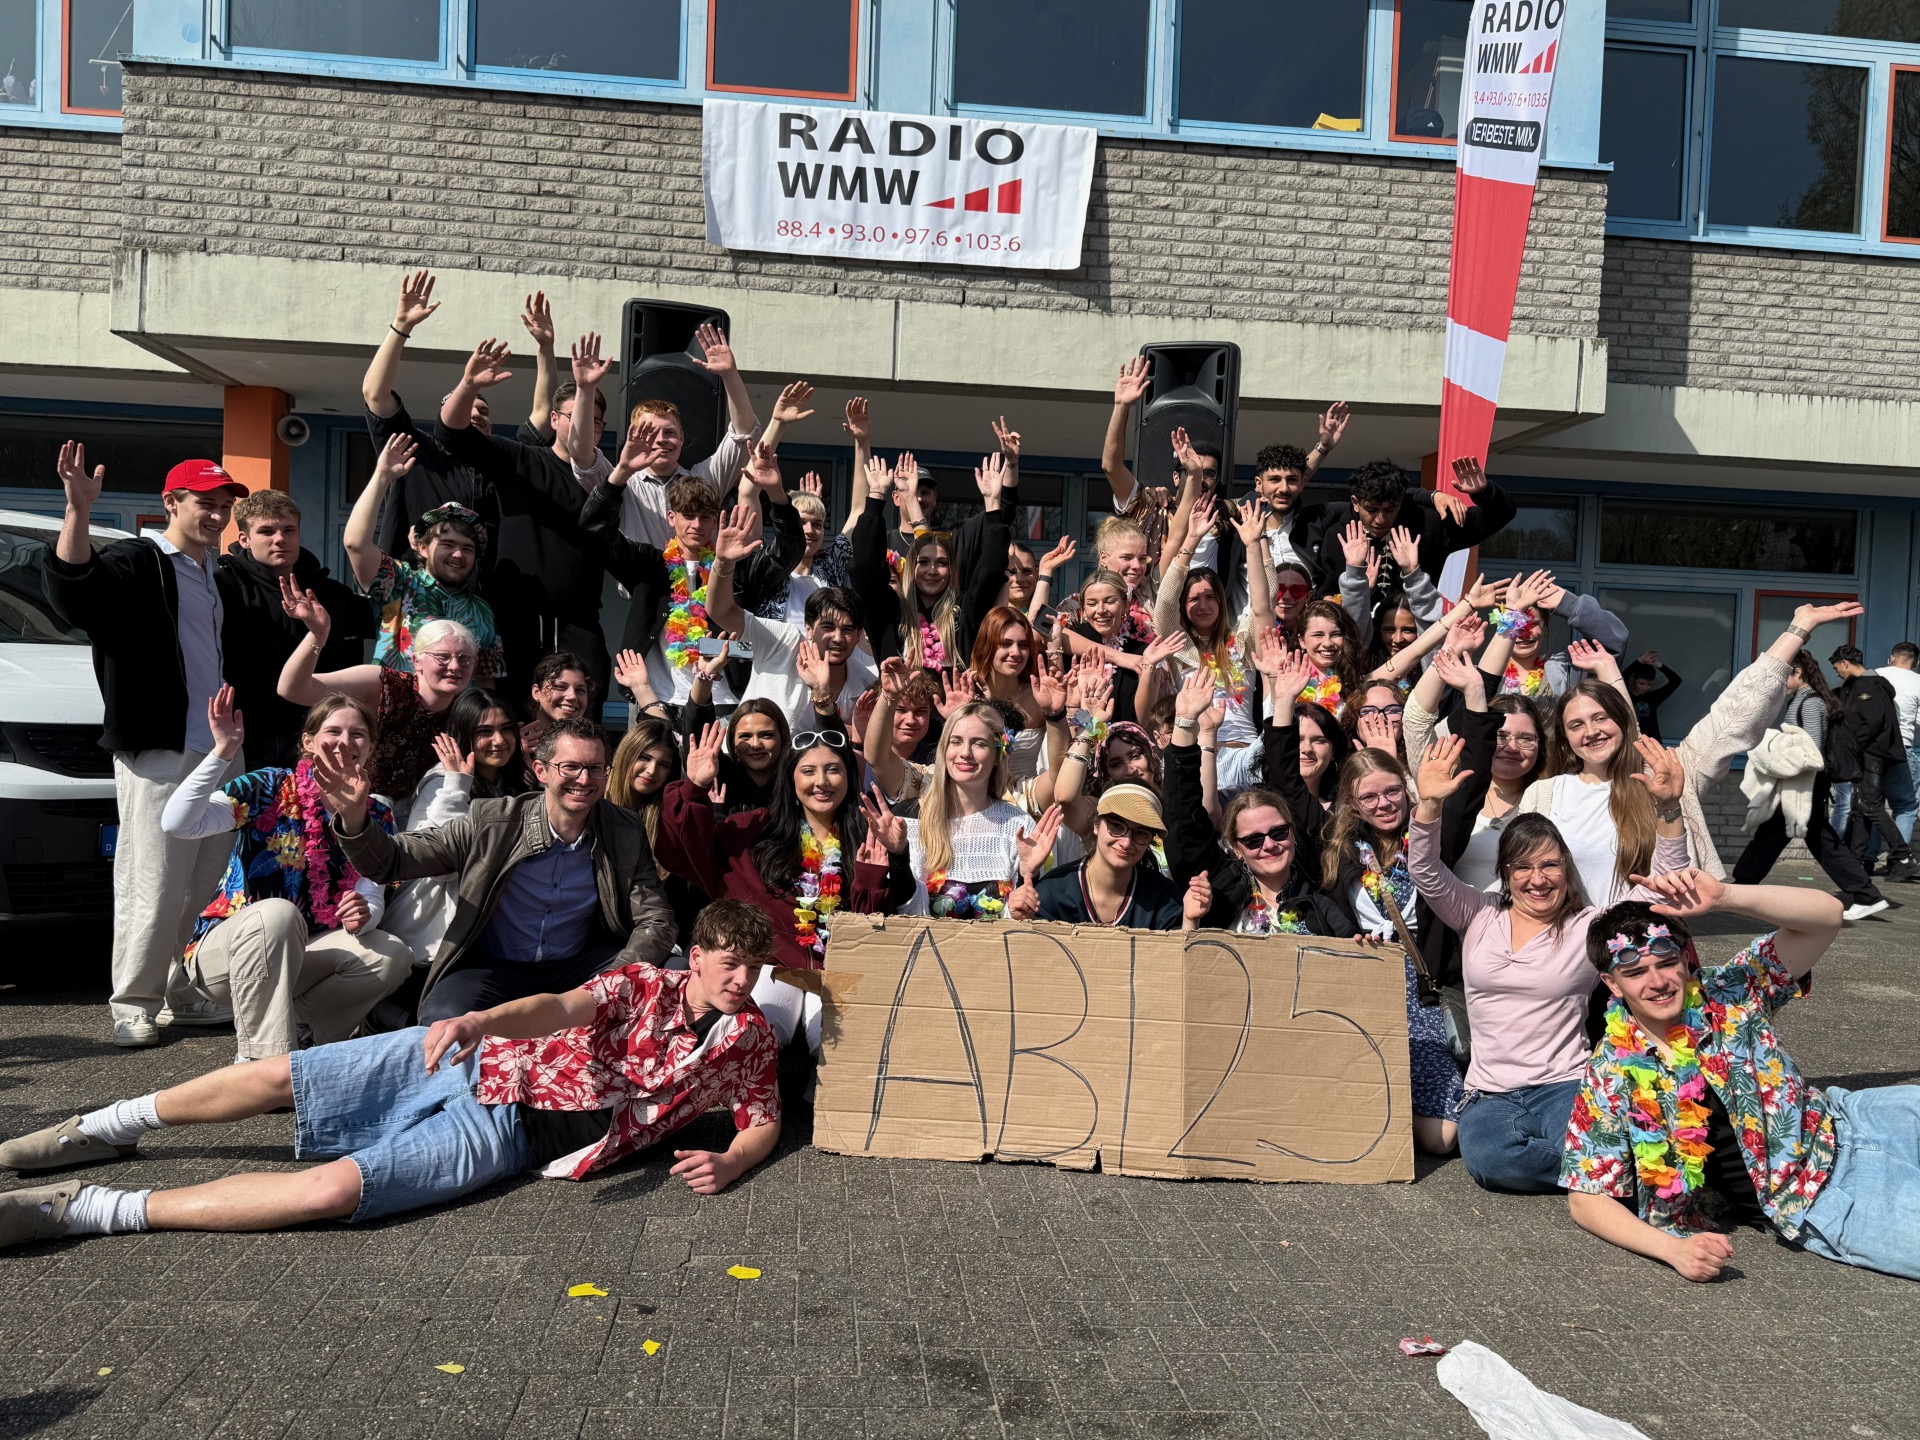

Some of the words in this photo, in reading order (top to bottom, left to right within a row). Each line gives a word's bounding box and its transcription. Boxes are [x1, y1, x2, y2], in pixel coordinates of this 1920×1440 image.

[1481, 0, 1564, 34] RADIO
[1477, 42, 1522, 74] WMW
[1489, 91, 1504, 106] 93.0
[1507, 92, 1523, 107] 97.6
[1527, 92, 1548, 107] 103.6
[779, 112, 1025, 165] RADIO
[777, 161, 920, 206] WMW
[776, 219, 822, 239] 88.4
[841, 223, 886, 243] 93.0
[904, 228, 948, 247] 97.6
[966, 233, 1021, 252] 103.6
[865, 926, 1137, 1169] ABI
[1167, 939, 1392, 1167] 25
